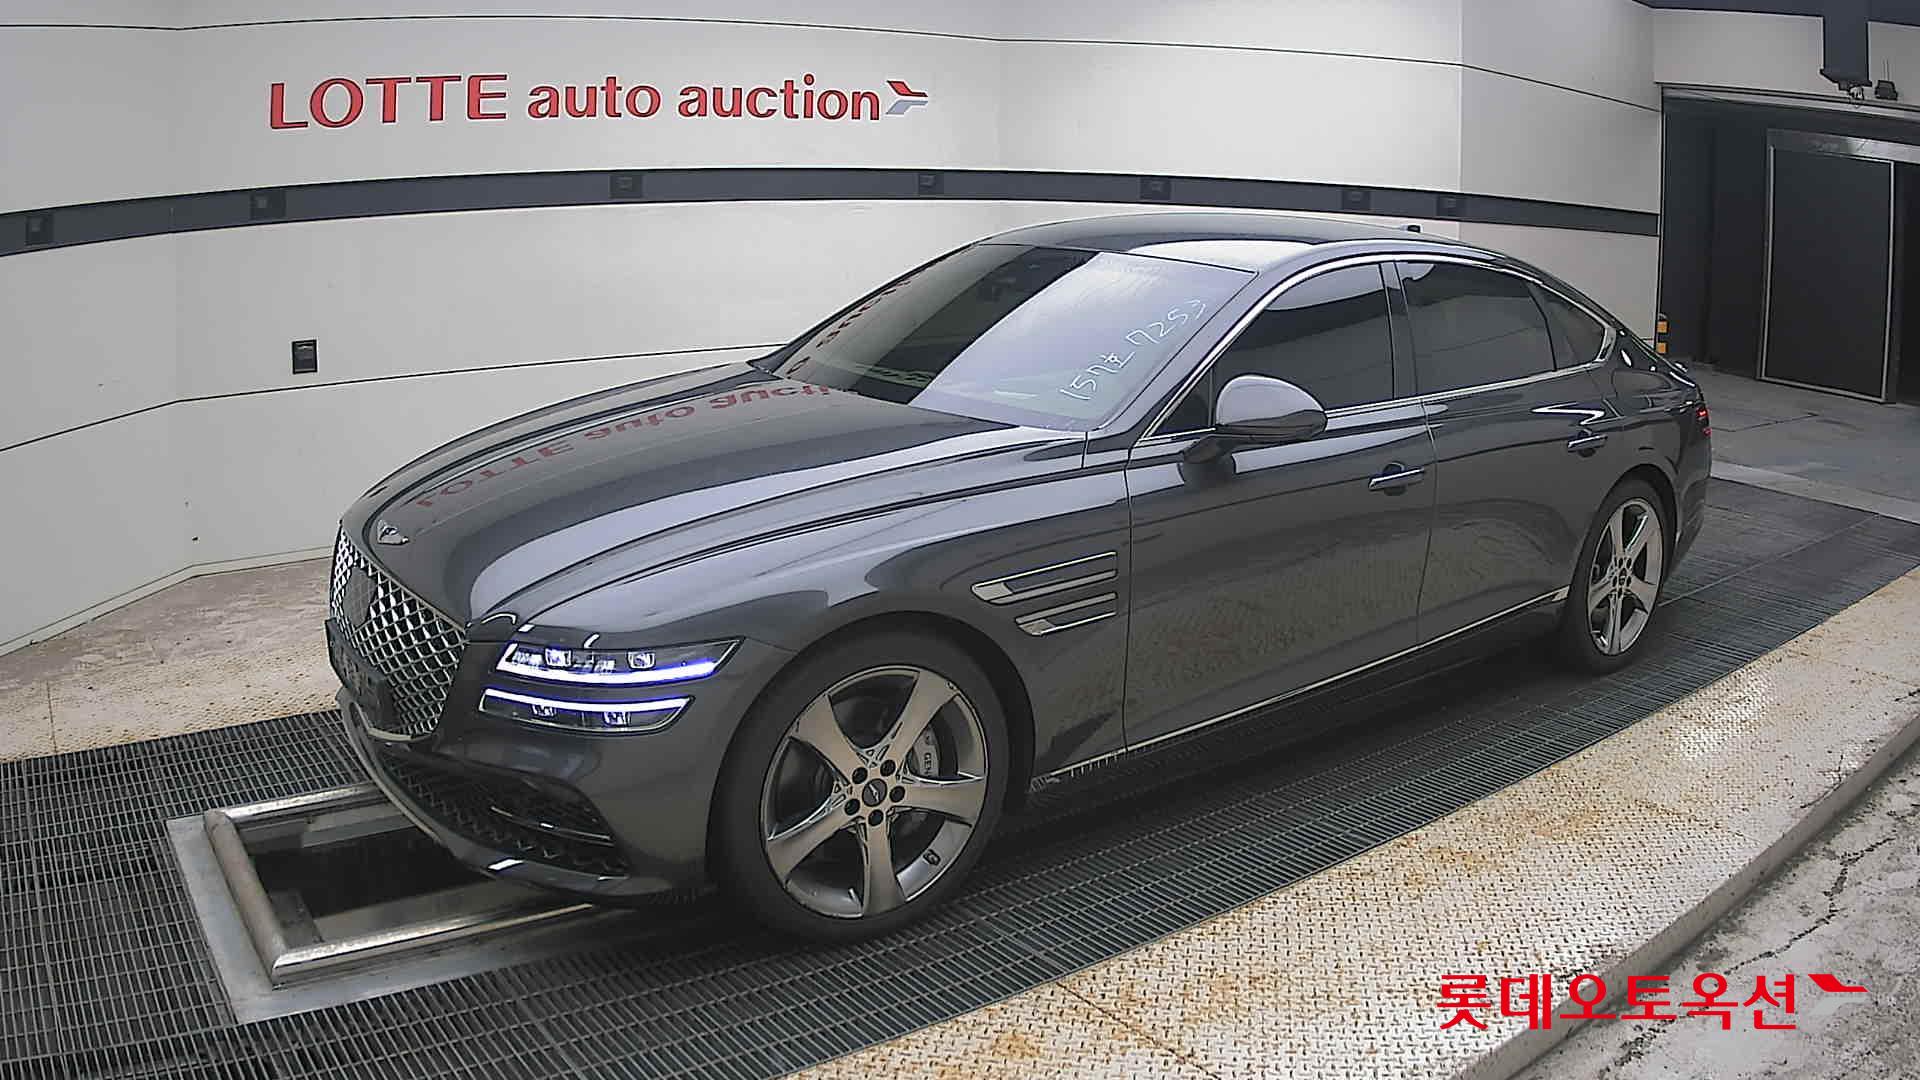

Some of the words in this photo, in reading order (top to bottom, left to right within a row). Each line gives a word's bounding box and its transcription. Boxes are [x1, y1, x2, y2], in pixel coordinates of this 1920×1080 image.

[269, 74, 508, 130] LOTTE
[527, 75, 662, 119] auto
[678, 73, 881, 121] auction
